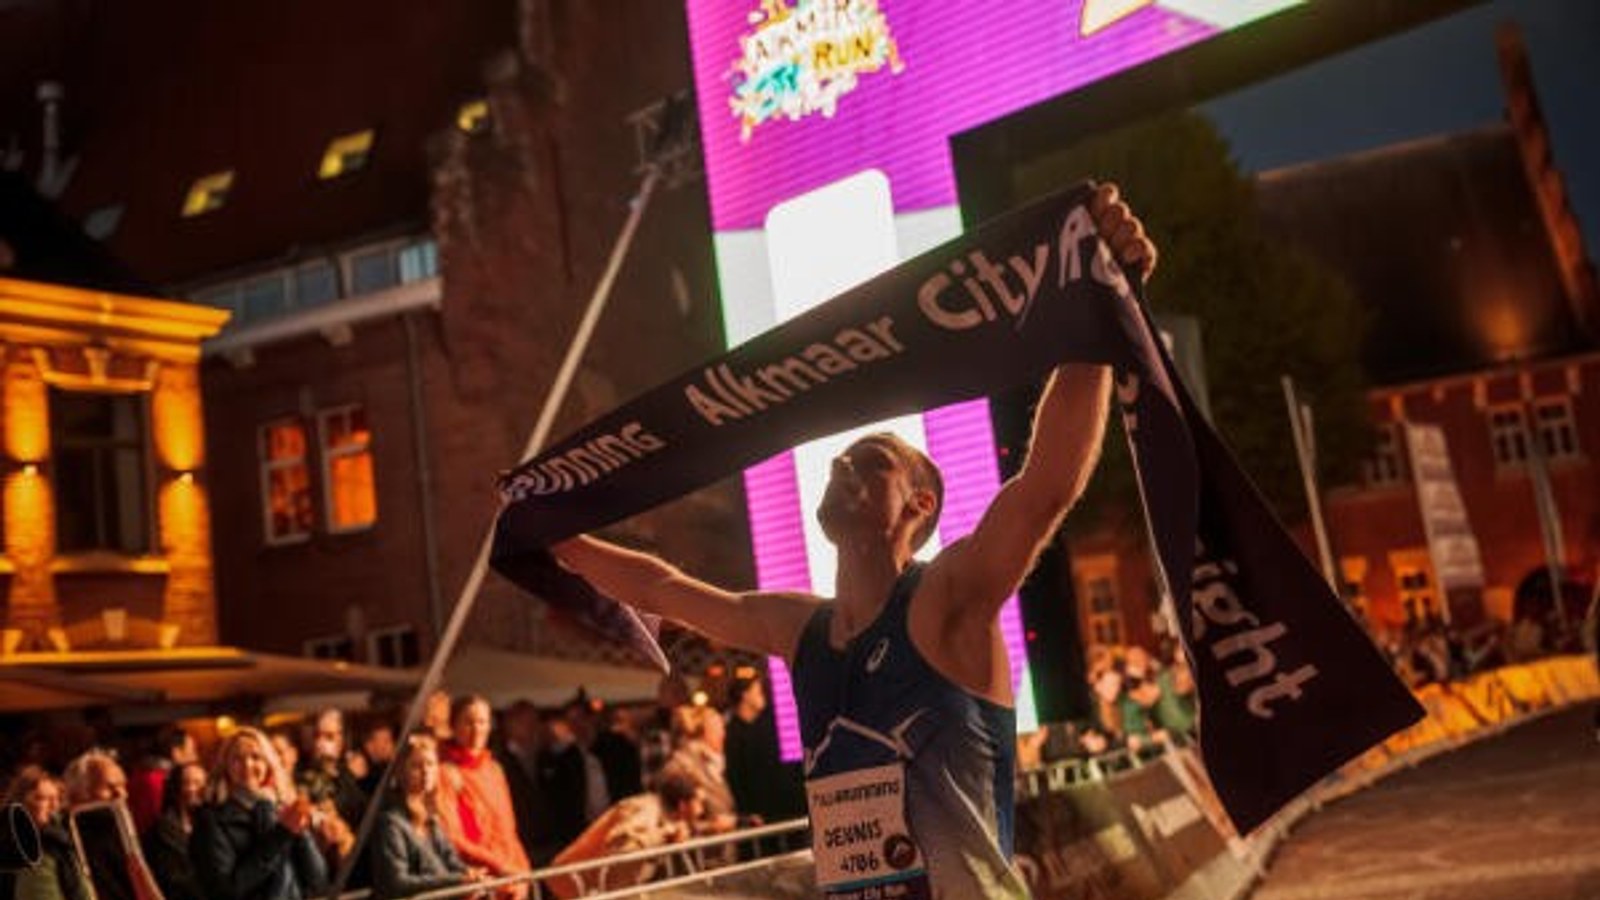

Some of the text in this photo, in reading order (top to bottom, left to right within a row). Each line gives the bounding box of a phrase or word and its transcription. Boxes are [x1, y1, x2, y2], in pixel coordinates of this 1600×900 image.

[812, 29, 877, 70] RUN
[684, 315, 904, 426] Alkmaar
[917, 243, 1050, 331] City
[824, 819, 883, 847] DENNIS
